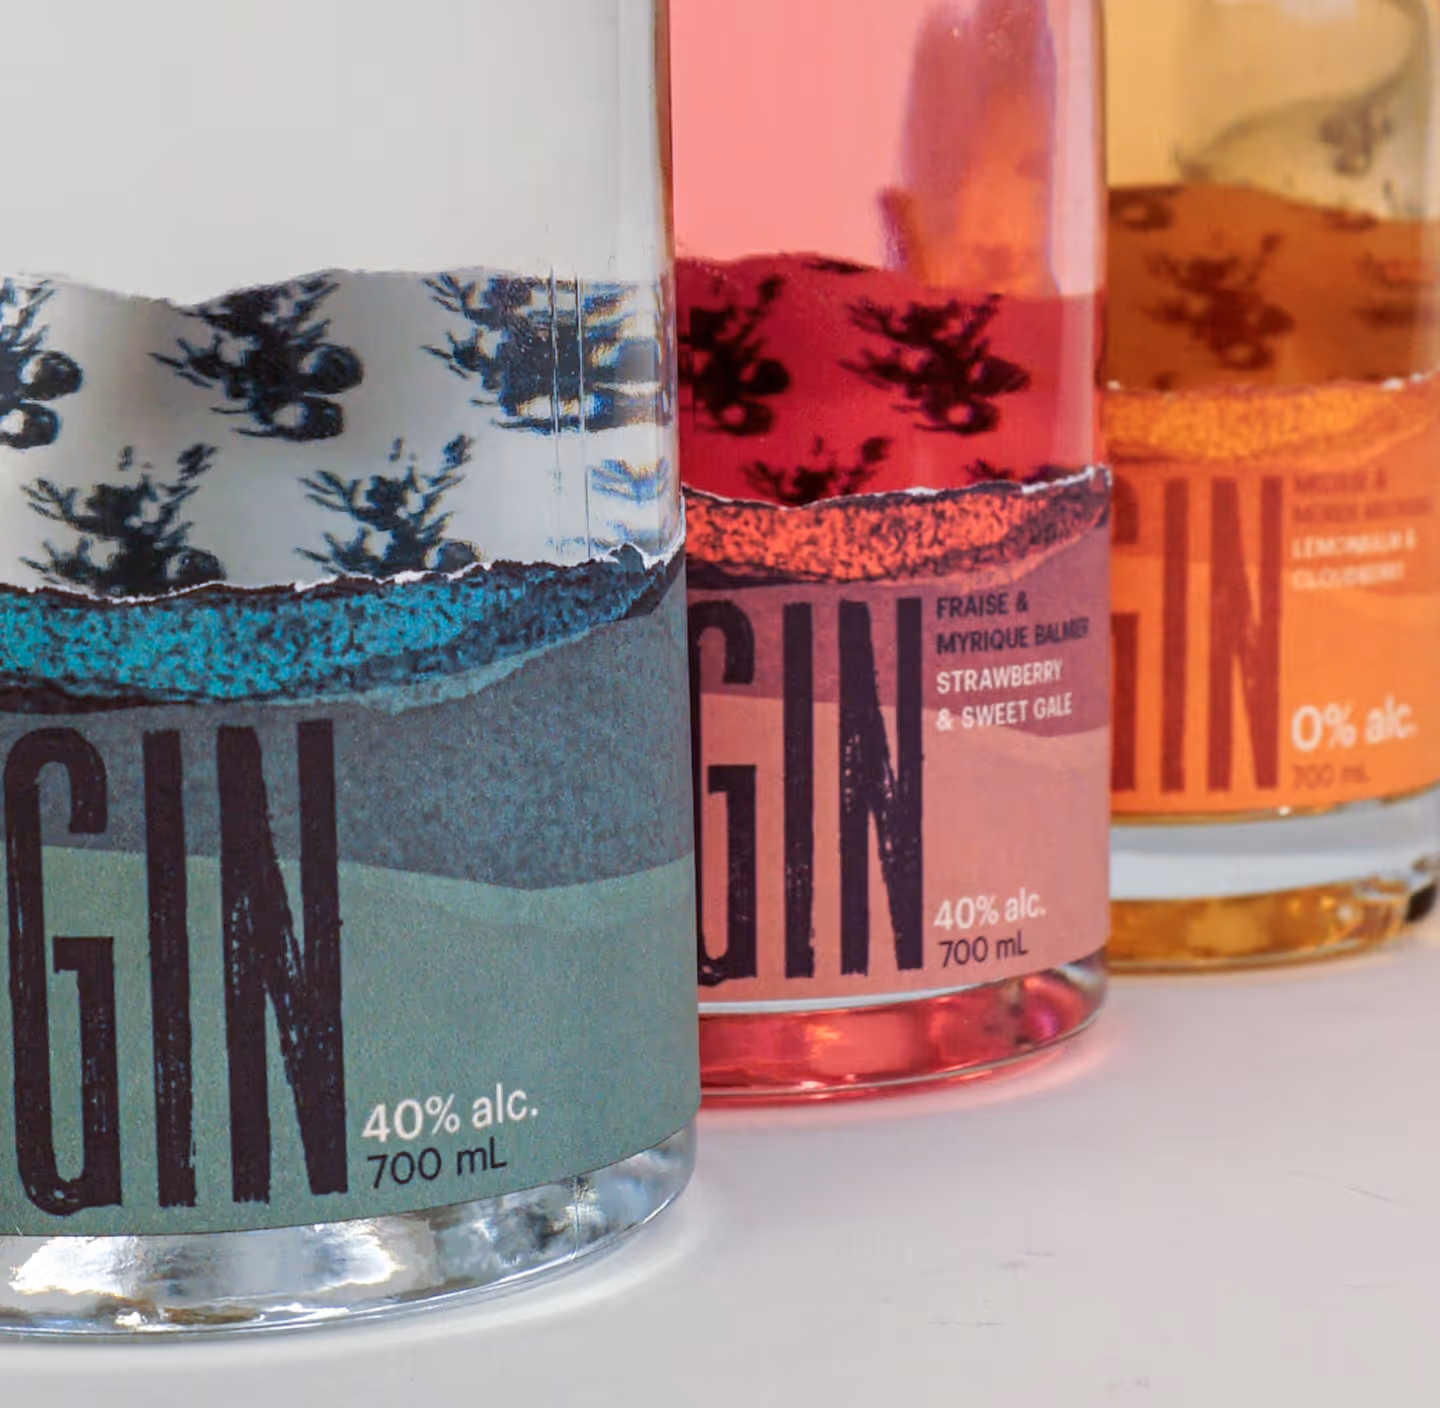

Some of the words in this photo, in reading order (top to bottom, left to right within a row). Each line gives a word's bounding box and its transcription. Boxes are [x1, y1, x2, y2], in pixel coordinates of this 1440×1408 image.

[936, 592, 1009, 619] FRAISE
[1016, 590, 1029, 612] &
[936, 626, 1028, 655] MYRIQUE
[936, 658, 1063, 694] STRAWBERRY
[936, 707, 953, 731] &
[961, 699, 1028, 729] SWEET
[1033, 691, 1073, 720] GALE
[1291, 700, 1357, 753] 0%
[684, 598, 923, 986] GIN
[933, 895, 999, 931] 40%
[1004, 886, 1047, 923] alc.
[3, 718, 348, 1217] GIN
[938, 935, 988, 968] 700
[996, 929, 1028, 961] mL
[360, 1094, 461, 1143] 40%
[471, 1082, 540, 1130] alc.
[367, 1147, 442, 1189] 700
[456, 1136, 508, 1177] mL
